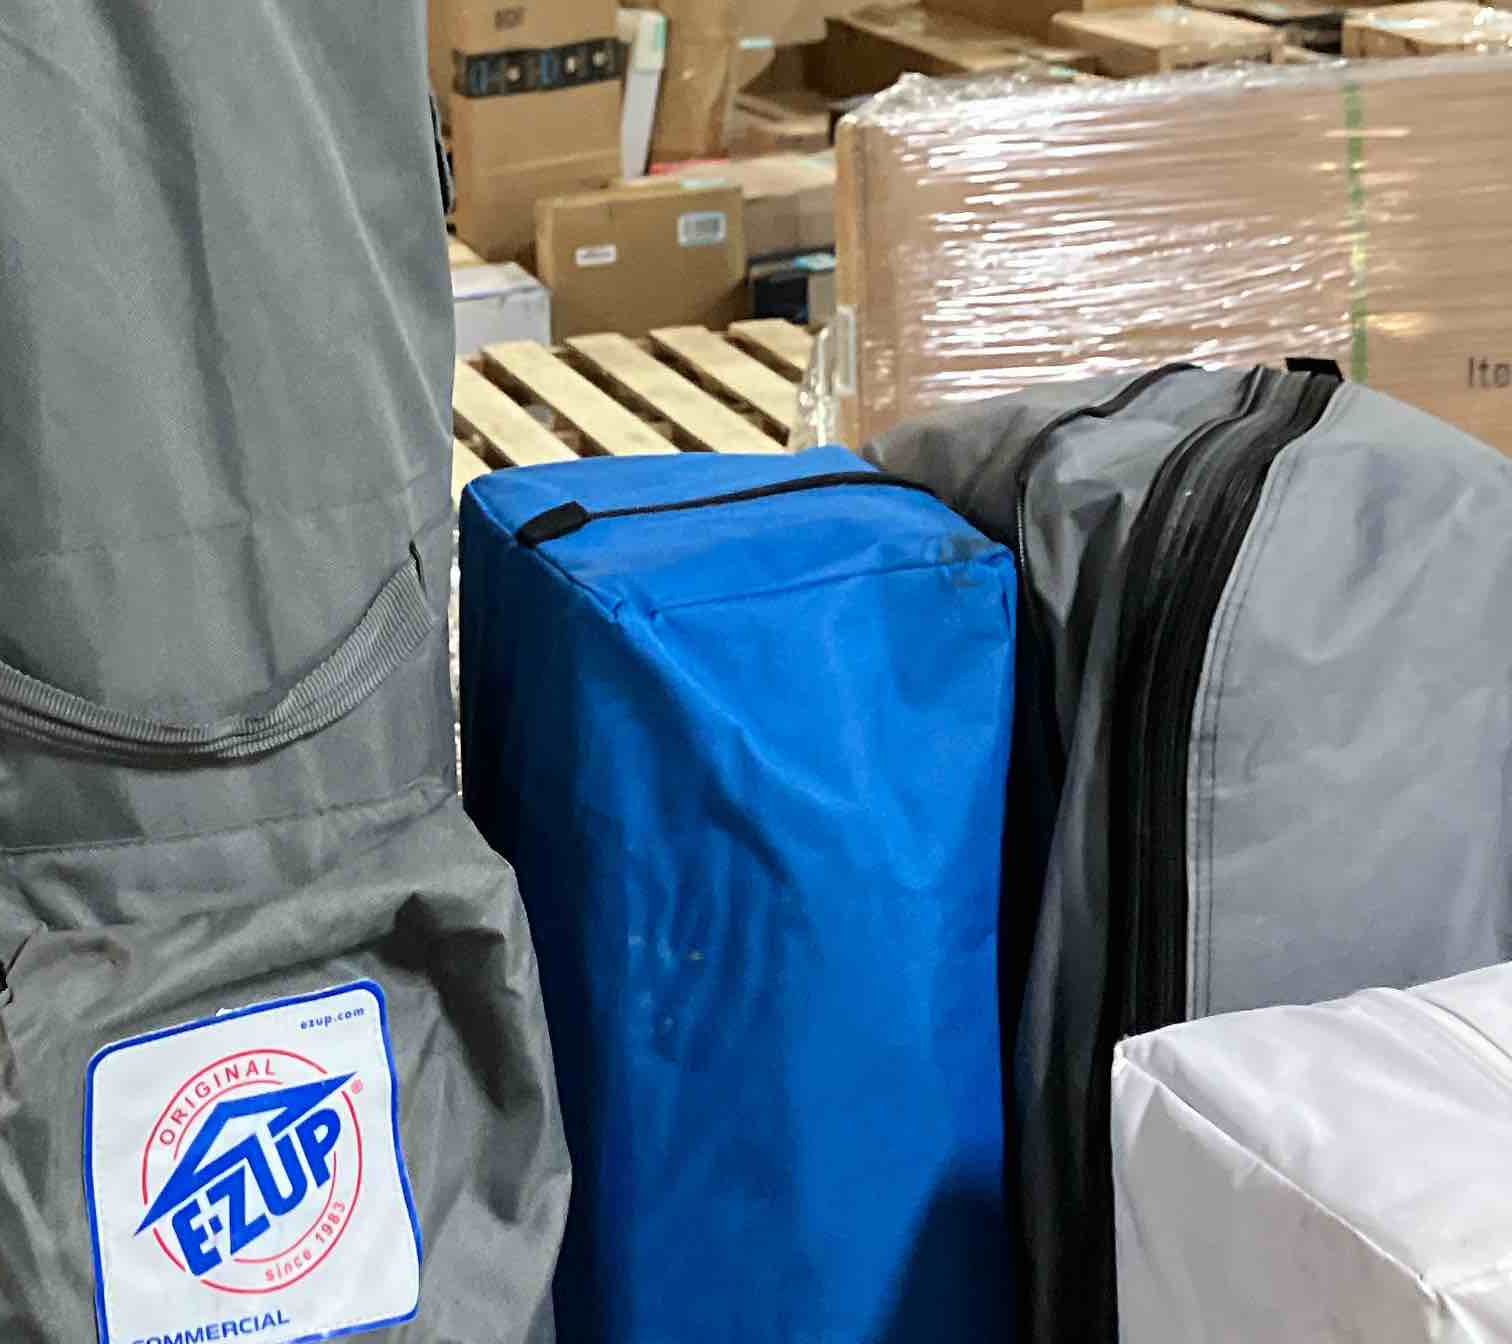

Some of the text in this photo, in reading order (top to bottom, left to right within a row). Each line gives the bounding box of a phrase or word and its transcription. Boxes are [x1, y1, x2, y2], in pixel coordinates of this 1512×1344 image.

[300, 1007, 365, 1030] ezup.com
[159, 1058, 278, 1147] ORIGINAL
[264, 1200, 345, 1283] since 1983
